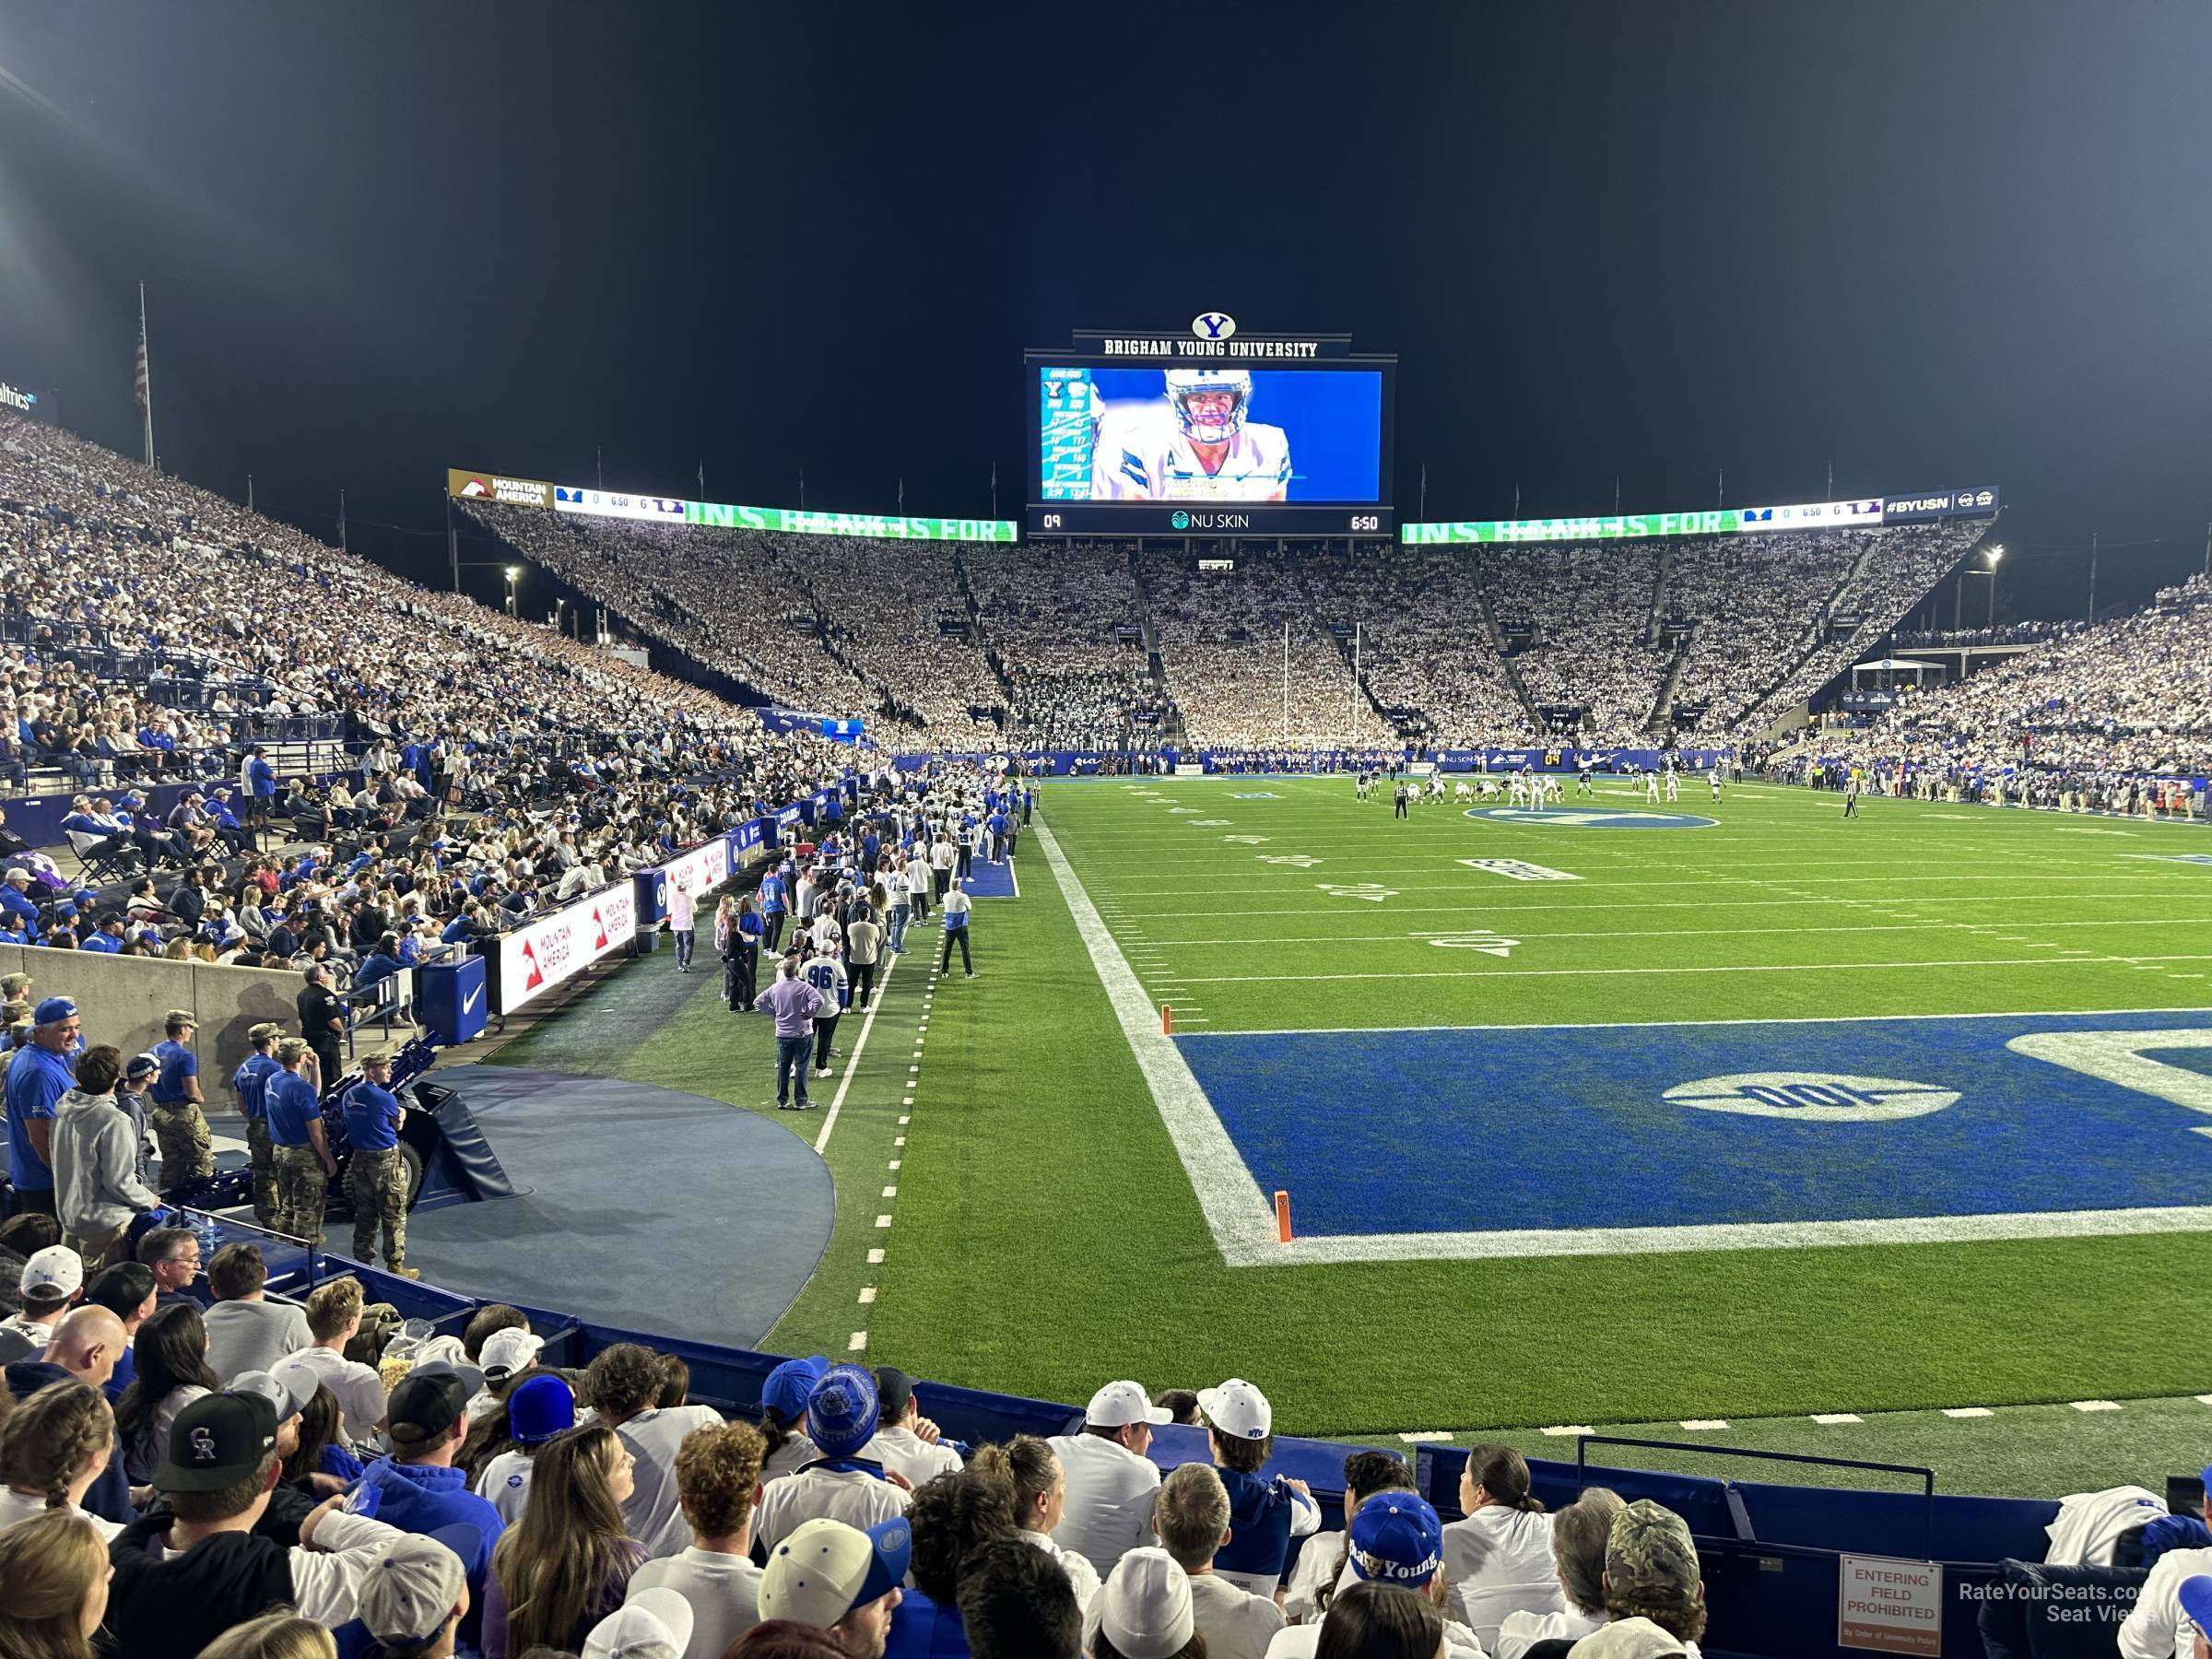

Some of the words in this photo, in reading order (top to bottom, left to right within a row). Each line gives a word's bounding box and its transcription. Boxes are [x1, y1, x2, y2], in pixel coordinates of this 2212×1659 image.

[1199, 315, 1229, 337] Y
[1105, 340, 1171, 356] BRIGHAM
[1177, 340, 1225, 357] YOUNG
[1230, 341, 1318, 358] UNIVERSITY
[492, 478, 547, 495] MOUNTAIN
[496, 489, 545, 505] AMERICA
[1886, 497, 1948, 513] #BYUSN
[1043, 515, 1061, 528] 09
[1192, 514, 1213, 528] NU
[1217, 514, 1249, 528] SKIN
[1351, 516, 1378, 530] 6:50
[1660, 511, 1724, 535] FOR
[940, 520, 997, 541] FOR
[1545, 755, 1559, 765] 09
[606, 897, 629, 916] MOUNTAIN
[608, 913, 629, 933] AMERICA
[540, 924, 571, 950] MOUNTAIN
[544, 944, 570, 969] AMERICA
[808, 966, 833, 989] 96
[1248, 1429, 1264, 1438] BYU
[1383, 1550, 1438, 1579] Young
[1855, 1569, 1929, 1586] ENTERING
[1871, 1586, 1912, 1601] FIELD
[1847, 1600, 1936, 1619] PROHIBITED
